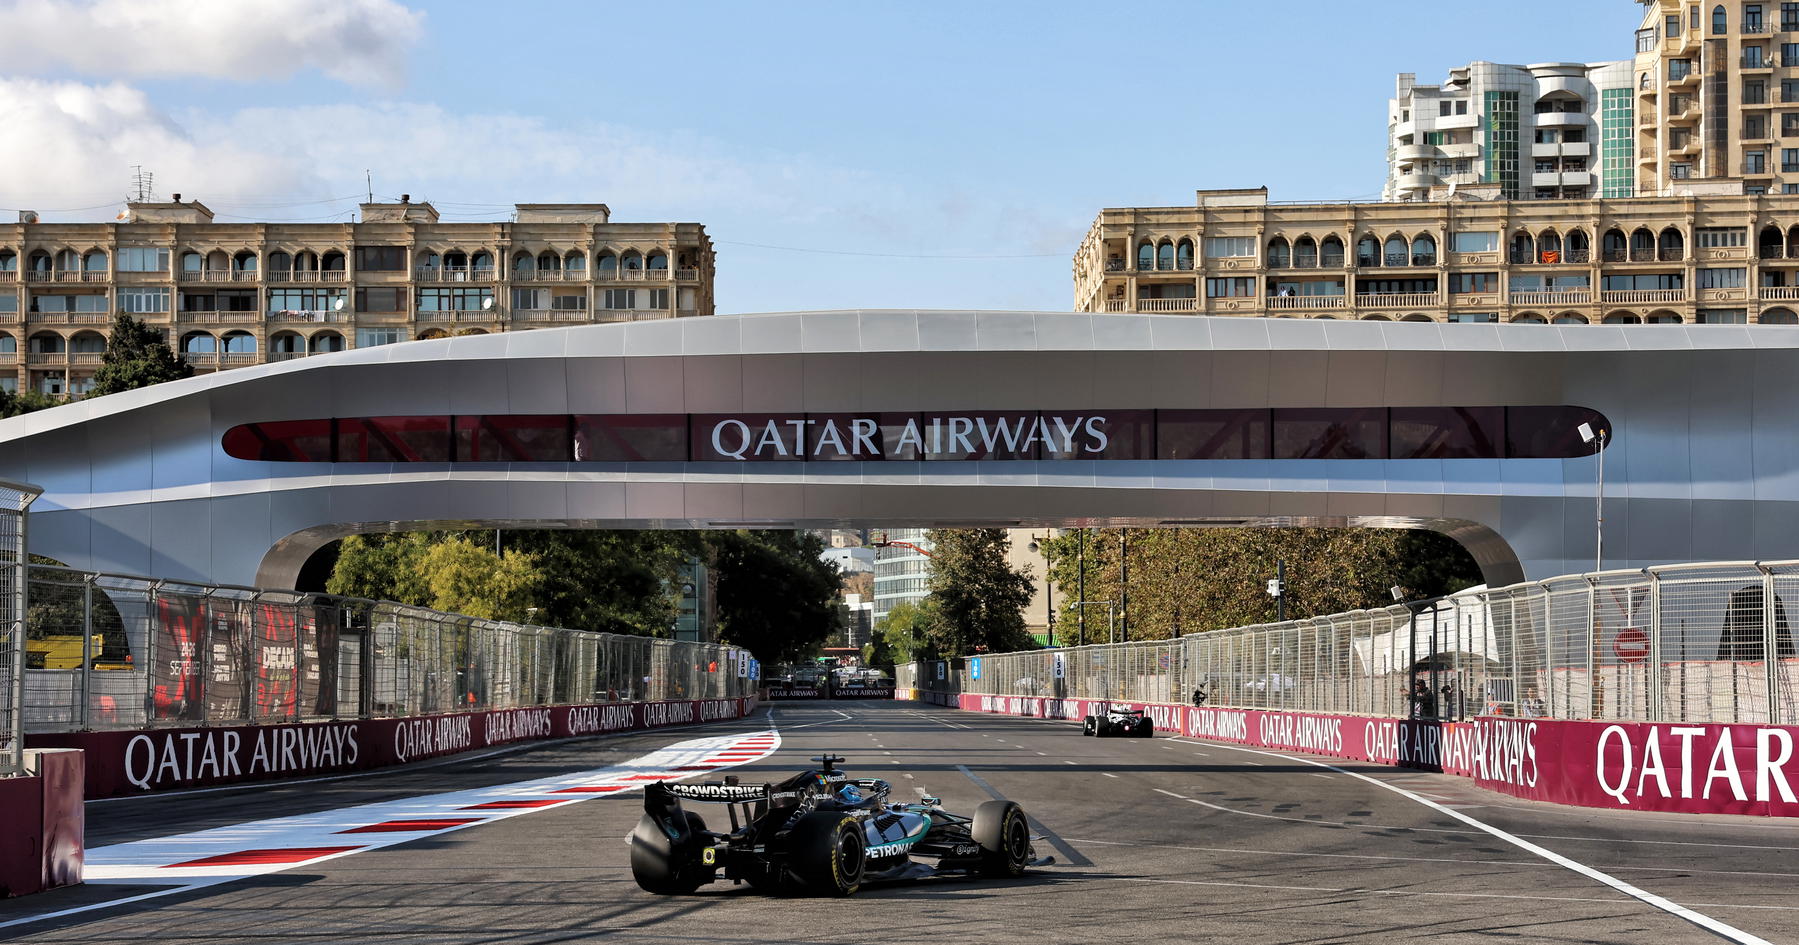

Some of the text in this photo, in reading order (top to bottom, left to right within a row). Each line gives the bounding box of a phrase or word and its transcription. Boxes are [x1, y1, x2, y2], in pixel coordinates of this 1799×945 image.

[711, 416, 1108, 460] QATAR AIRWAYS
[835, 689, 859, 697] QATAR
[485, 709, 551, 745] QATAR AIRWAYS
[568, 705, 634, 735] QATAR AIRWAYS
[643, 702, 694, 727] QATAR AIRWAYS
[1188, 709, 1216, 737] QATAR
[1216, 711, 1247, 740] AIRWAYS
[1259, 712, 1342, 753] QATAR AIRWAYS
[125, 725, 358, 790] QATAR AIRWAYS
[395, 716, 471, 763] QATAR AIRWAYS
[1364, 721, 1474, 771] QATAR AIRWAY
[1596, 725, 1798, 804] QATAR
[672, 784, 765, 797] CROWDSTRIKE
